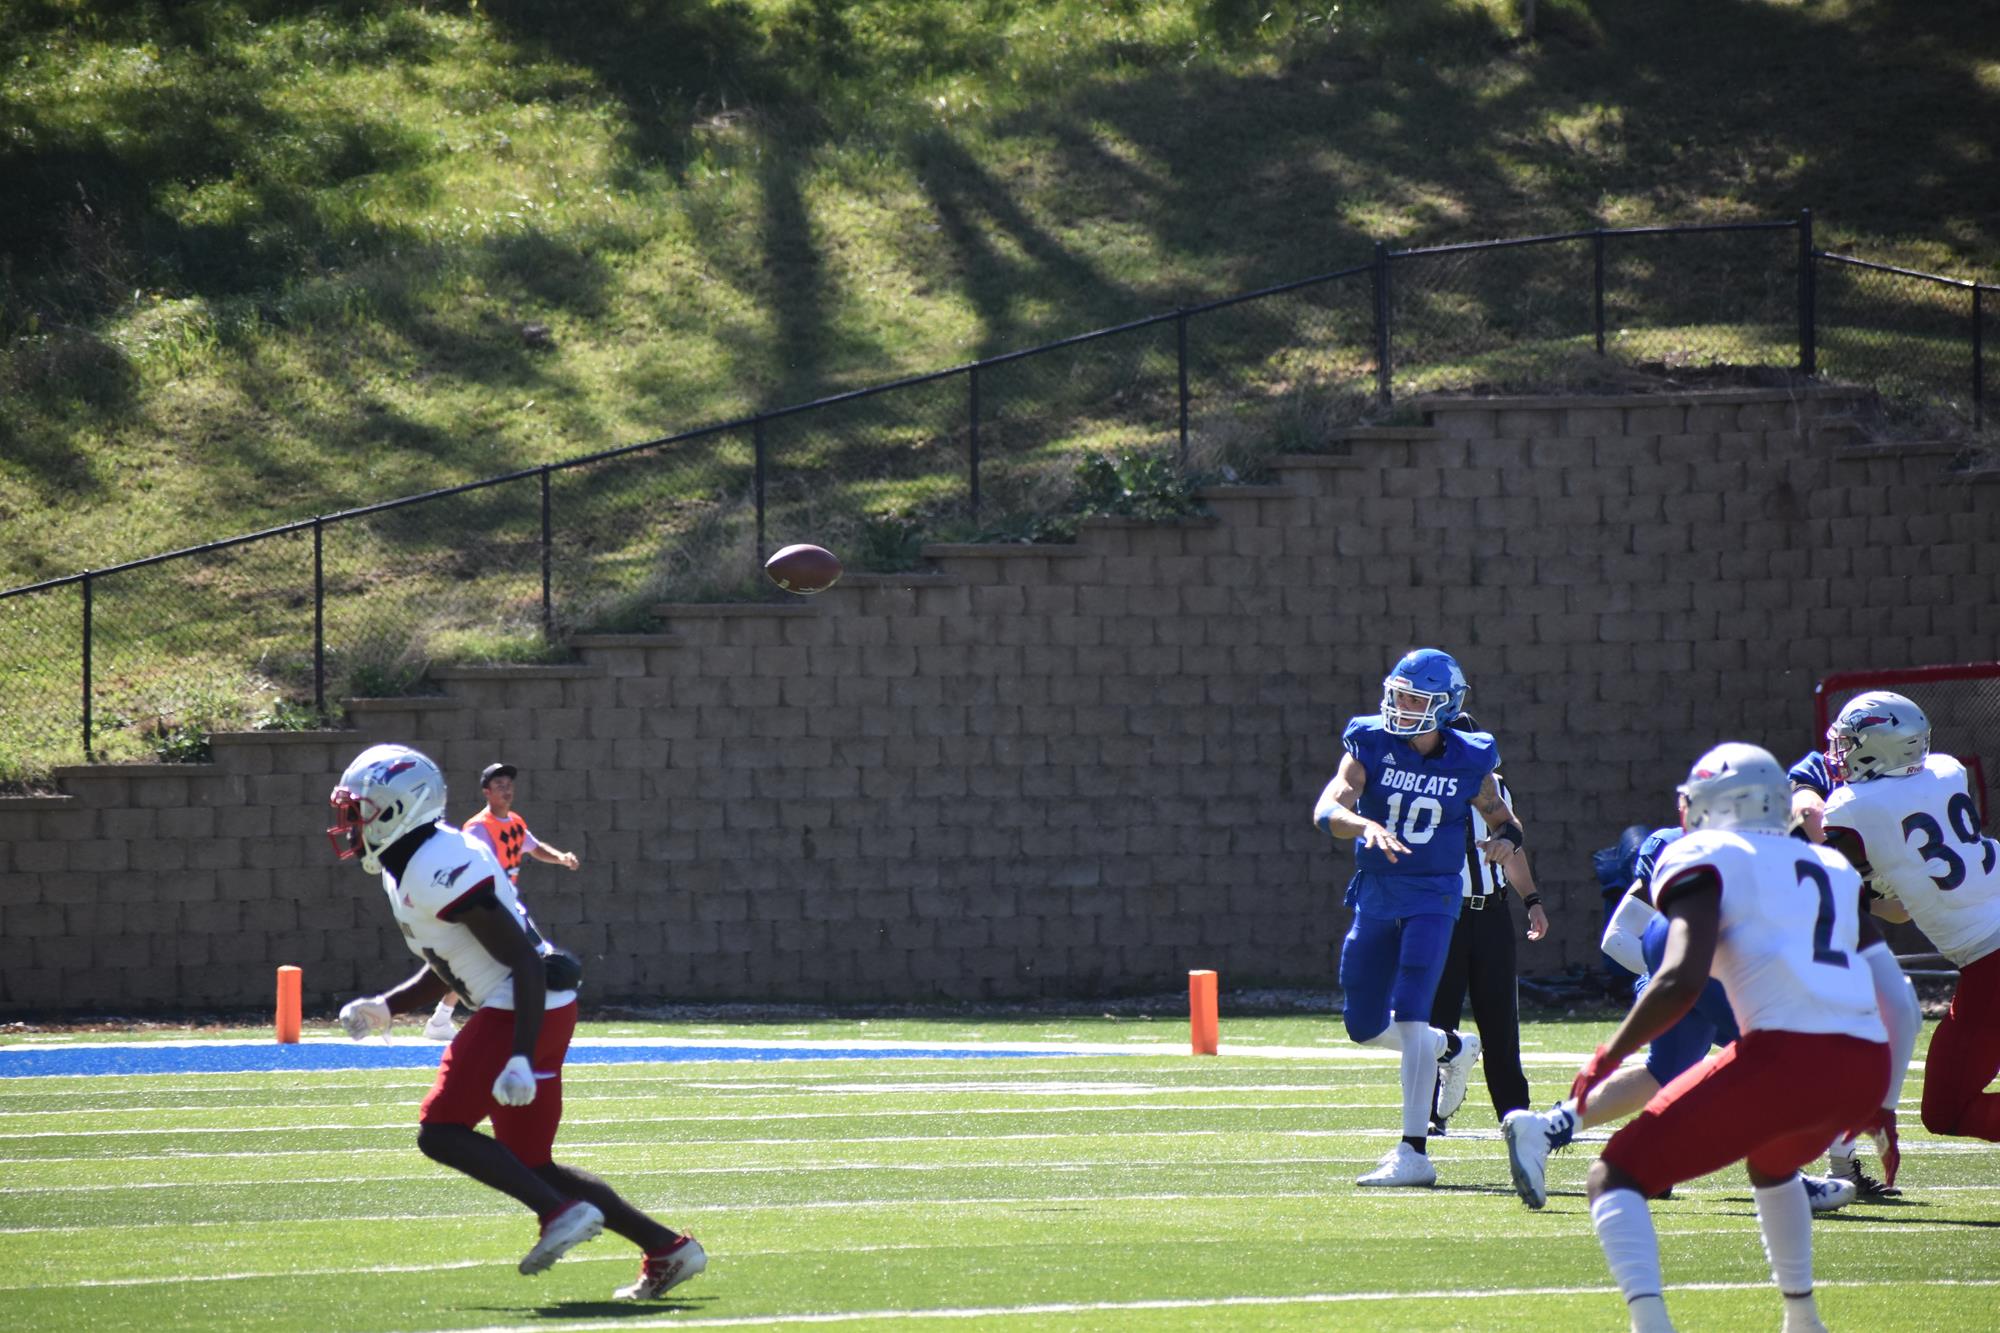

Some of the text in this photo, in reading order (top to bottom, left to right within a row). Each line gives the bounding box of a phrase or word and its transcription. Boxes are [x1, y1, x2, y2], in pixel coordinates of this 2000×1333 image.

[1381, 767, 1458, 797] BOBCATS
[1385, 792, 1443, 844] 10
[1901, 792, 1996, 891] 39
[1795, 859, 1850, 970] 2
